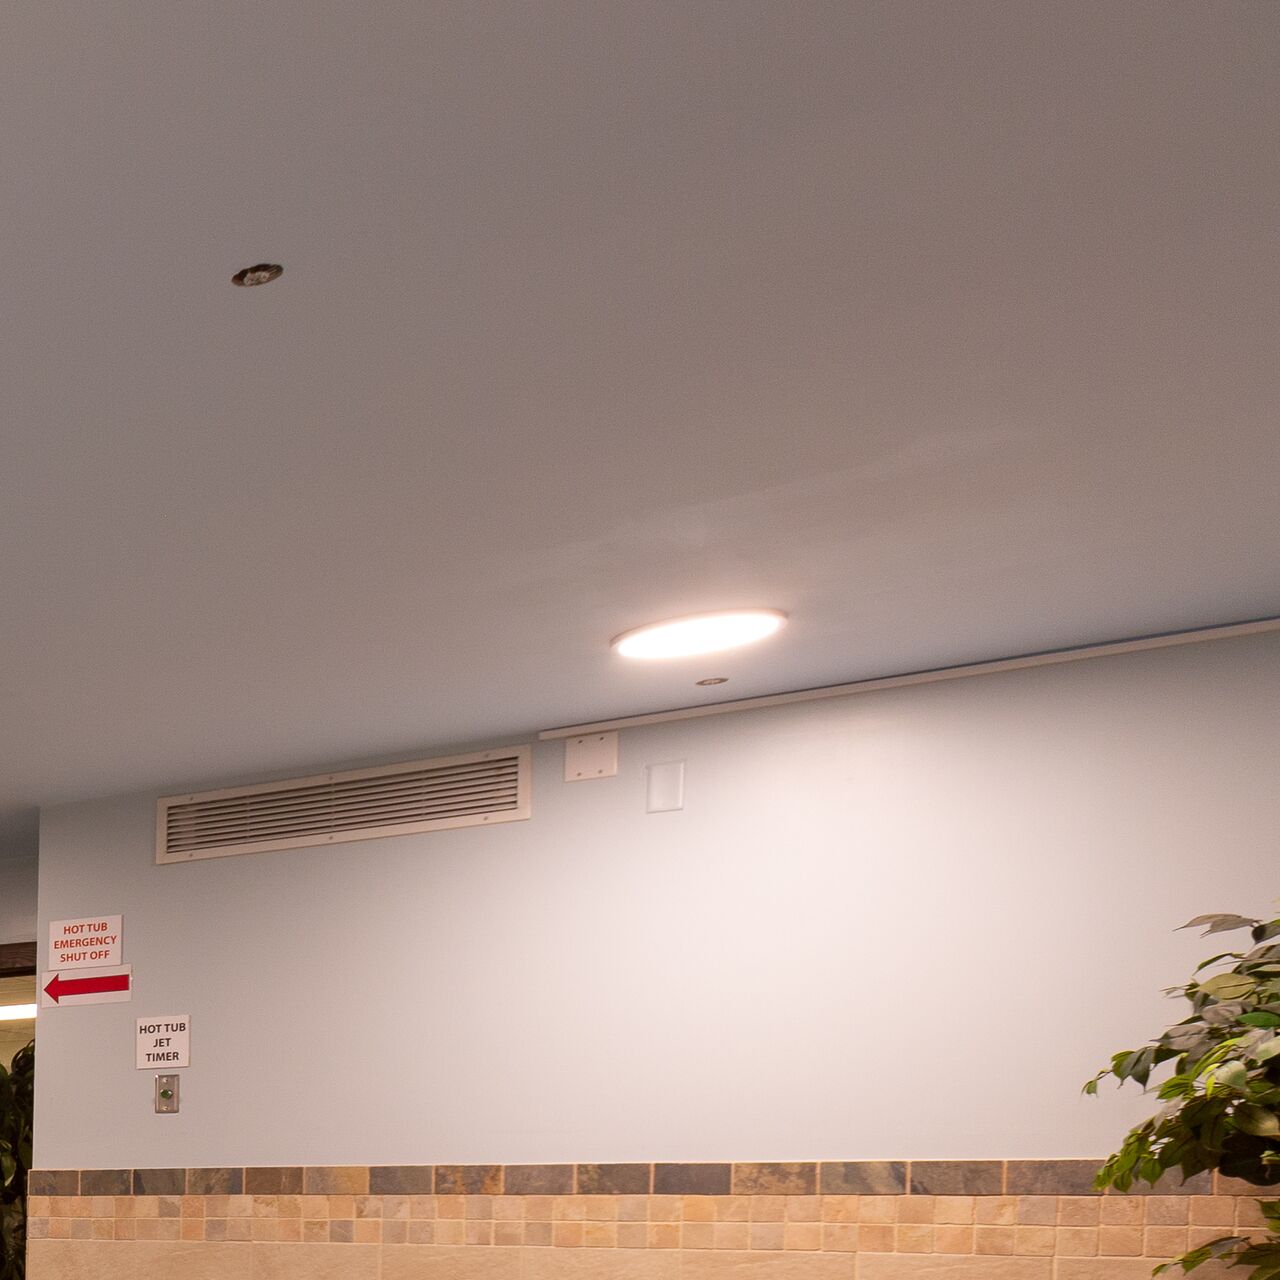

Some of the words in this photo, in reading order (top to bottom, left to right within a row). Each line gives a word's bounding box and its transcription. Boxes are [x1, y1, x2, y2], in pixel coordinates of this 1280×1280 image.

[63, 924, 85, 935] HOT
[87, 922, 108, 932] TUB
[53, 935, 117, 949] EMERGENCY
[60, 952, 87, 962] SHUT
[90, 950, 110, 960] OFF
[139, 1024, 162, 1034] HOT
[164, 1022, 186, 1032] TUB
[153, 1037, 172, 1048] JET
[145, 1051, 179, 1062] TIMER
